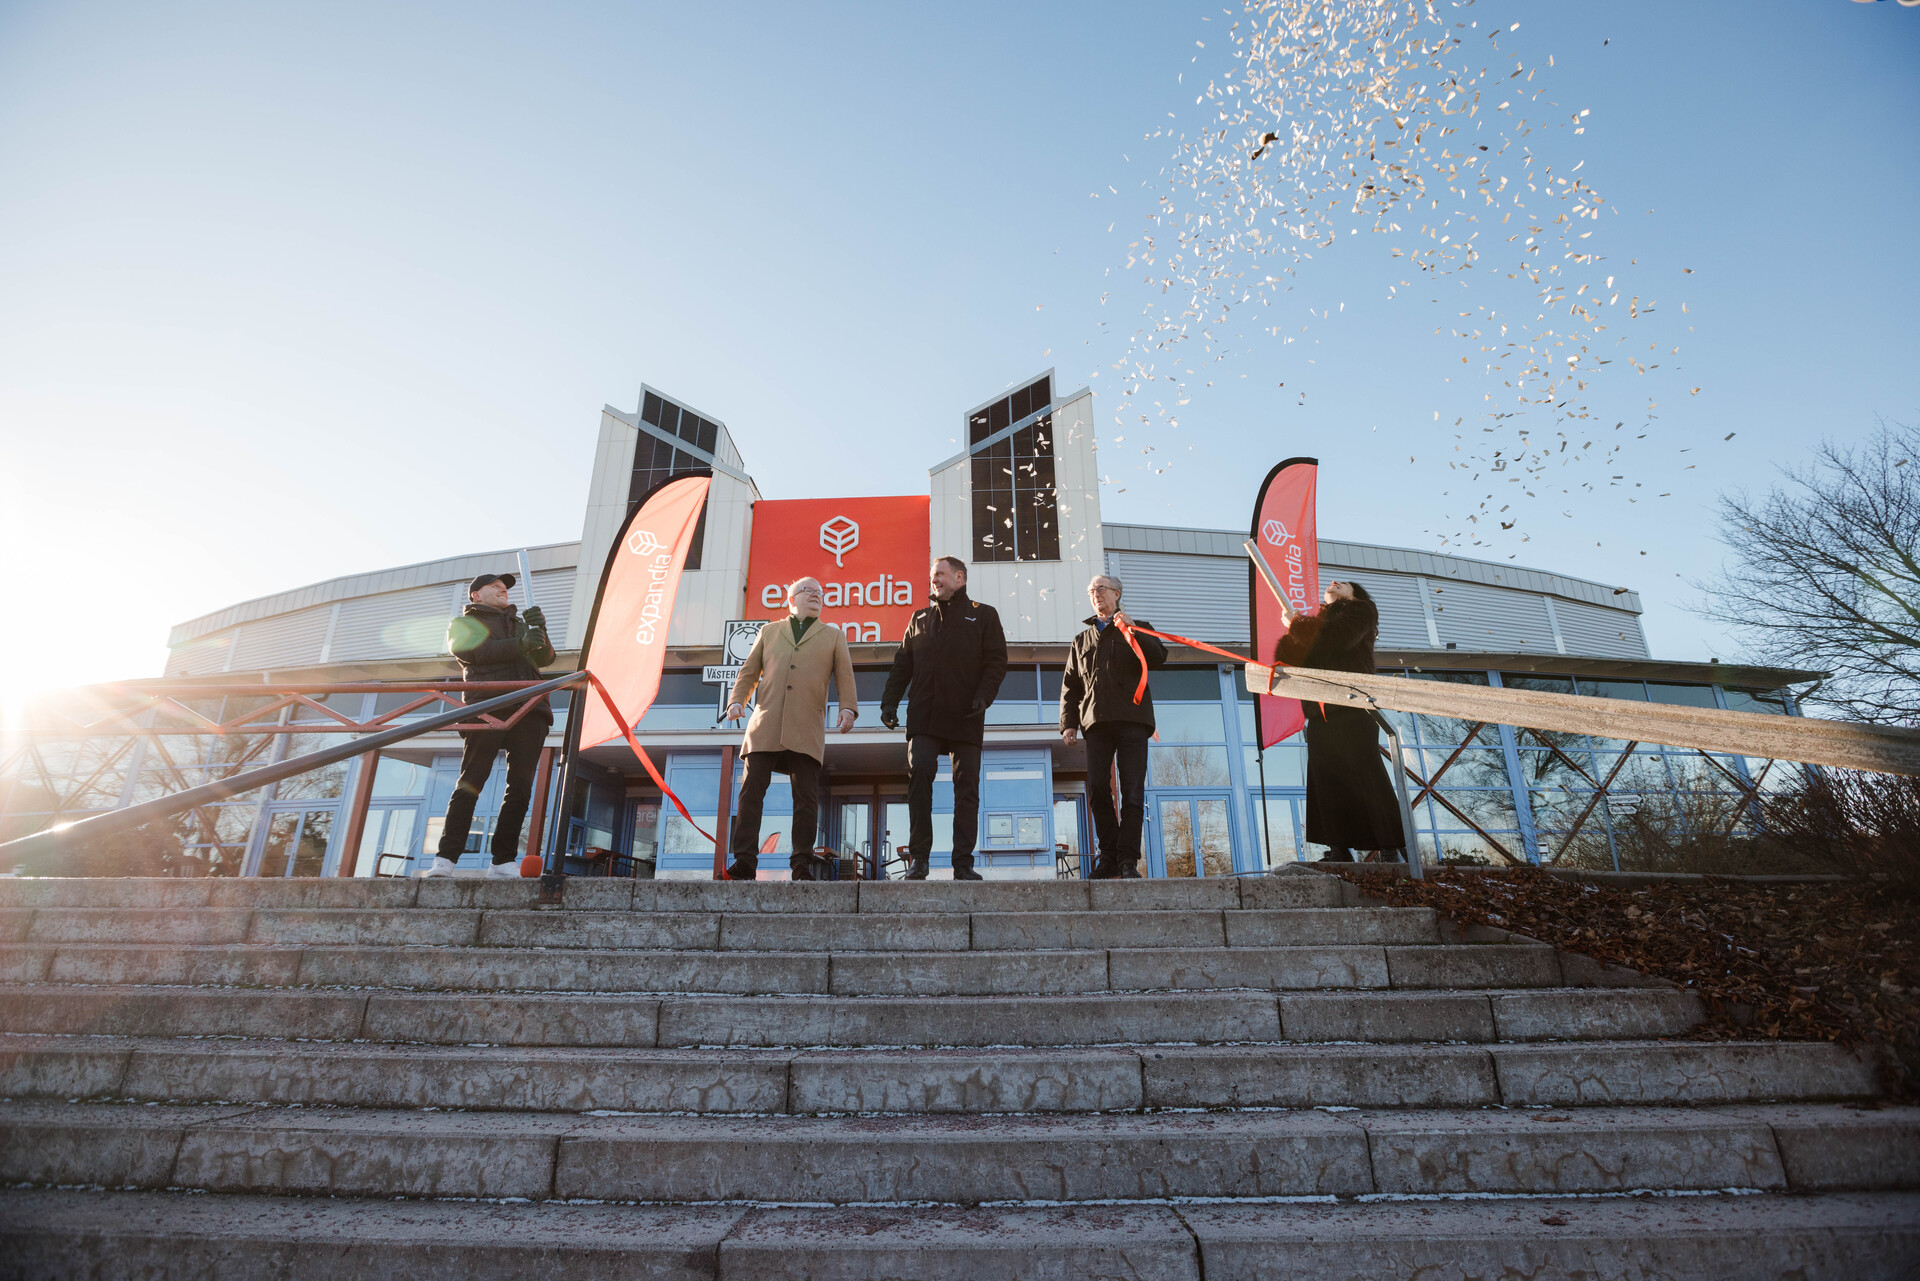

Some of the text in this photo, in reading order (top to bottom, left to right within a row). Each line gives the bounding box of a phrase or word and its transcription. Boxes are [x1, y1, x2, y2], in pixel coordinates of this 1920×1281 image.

[636, 554, 672, 645] expandia
[761, 573, 913, 609] eandia
[1285, 543, 1313, 616] pandia
[826, 621, 881, 642] na
